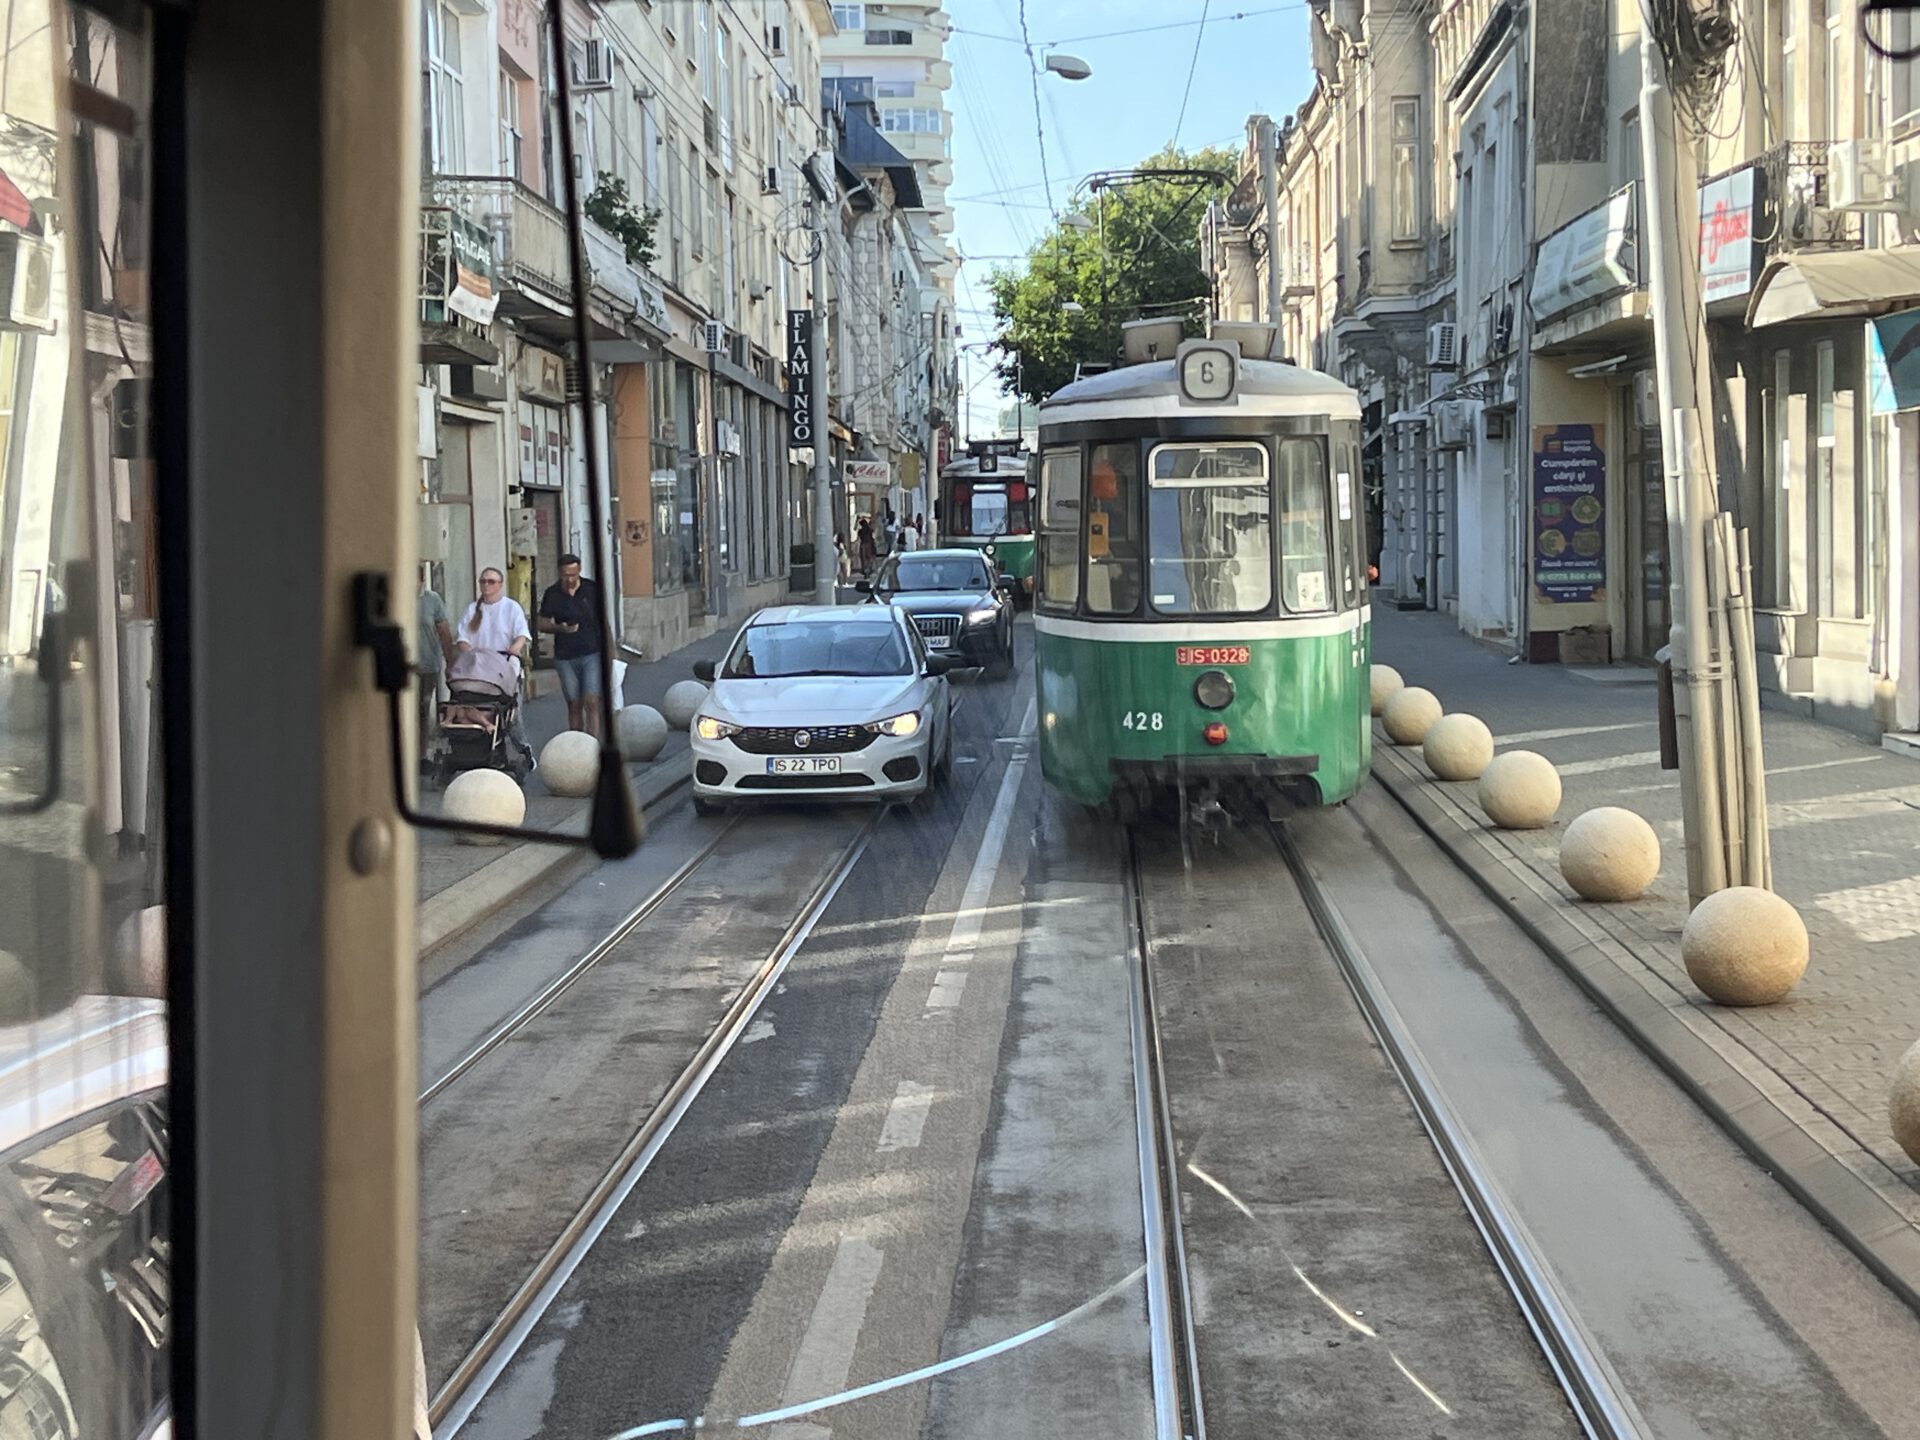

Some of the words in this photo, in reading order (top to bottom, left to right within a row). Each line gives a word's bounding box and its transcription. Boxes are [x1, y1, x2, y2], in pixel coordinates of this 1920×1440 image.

[791, 313, 811, 441] FLAMINGO
[1201, 361, 1214, 384] 6
[1122, 711, 1163, 731] 428
[775, 759, 787, 772] IS
[791, 759, 806, 771] 22
[811, 759, 837, 771] TPO
